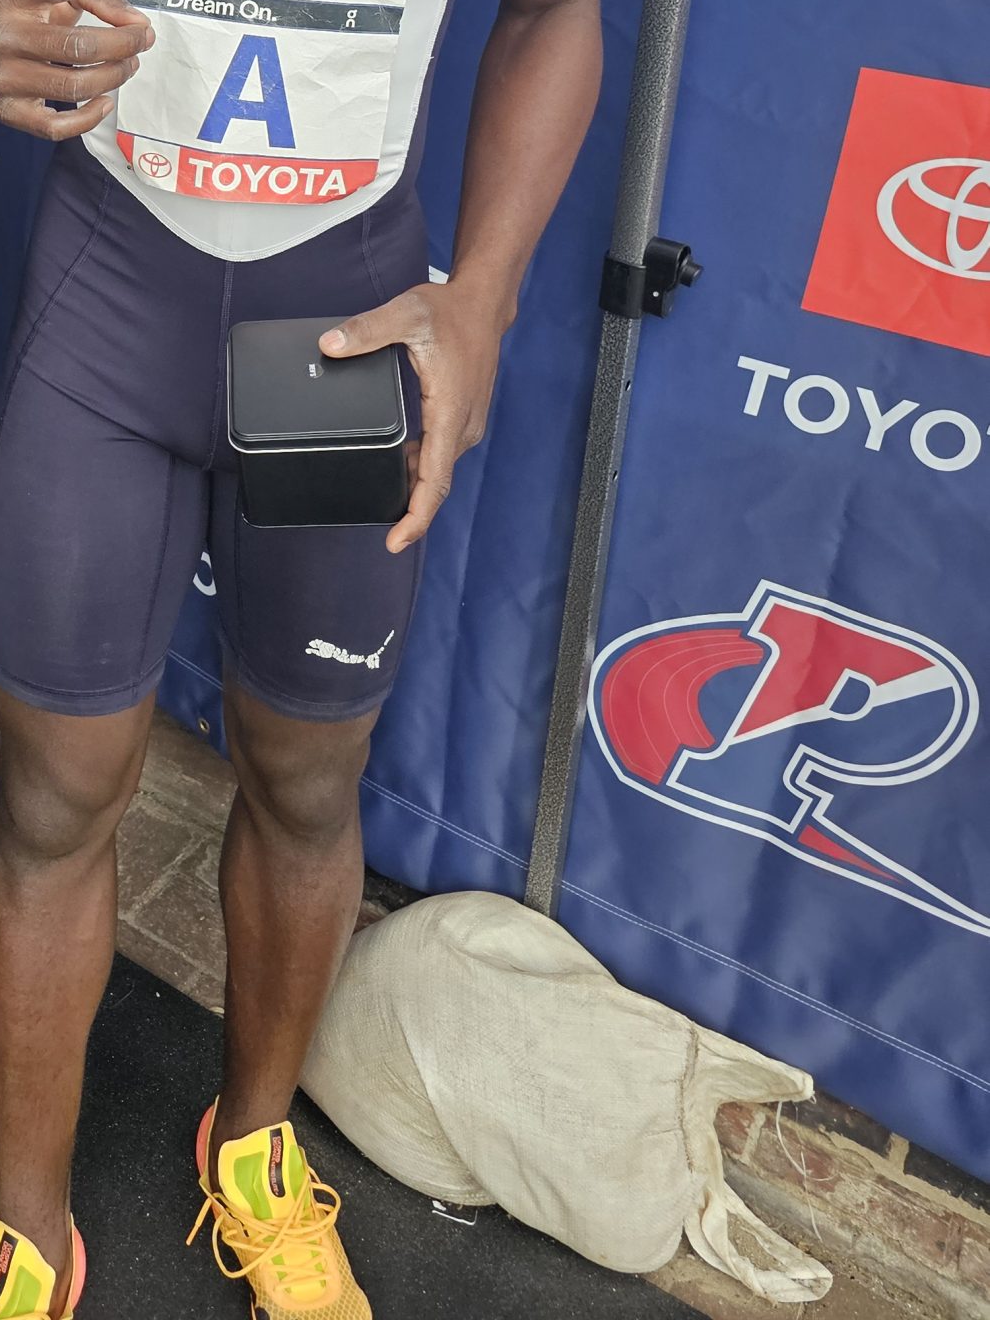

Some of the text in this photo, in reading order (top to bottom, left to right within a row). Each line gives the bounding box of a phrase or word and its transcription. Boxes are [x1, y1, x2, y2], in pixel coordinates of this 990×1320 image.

[238, 0, 278, 23] On.
[196, 33, 296, 149] A
[188, 157, 347, 196] TOYOTA
[737, 355, 990, 473] TOYO
